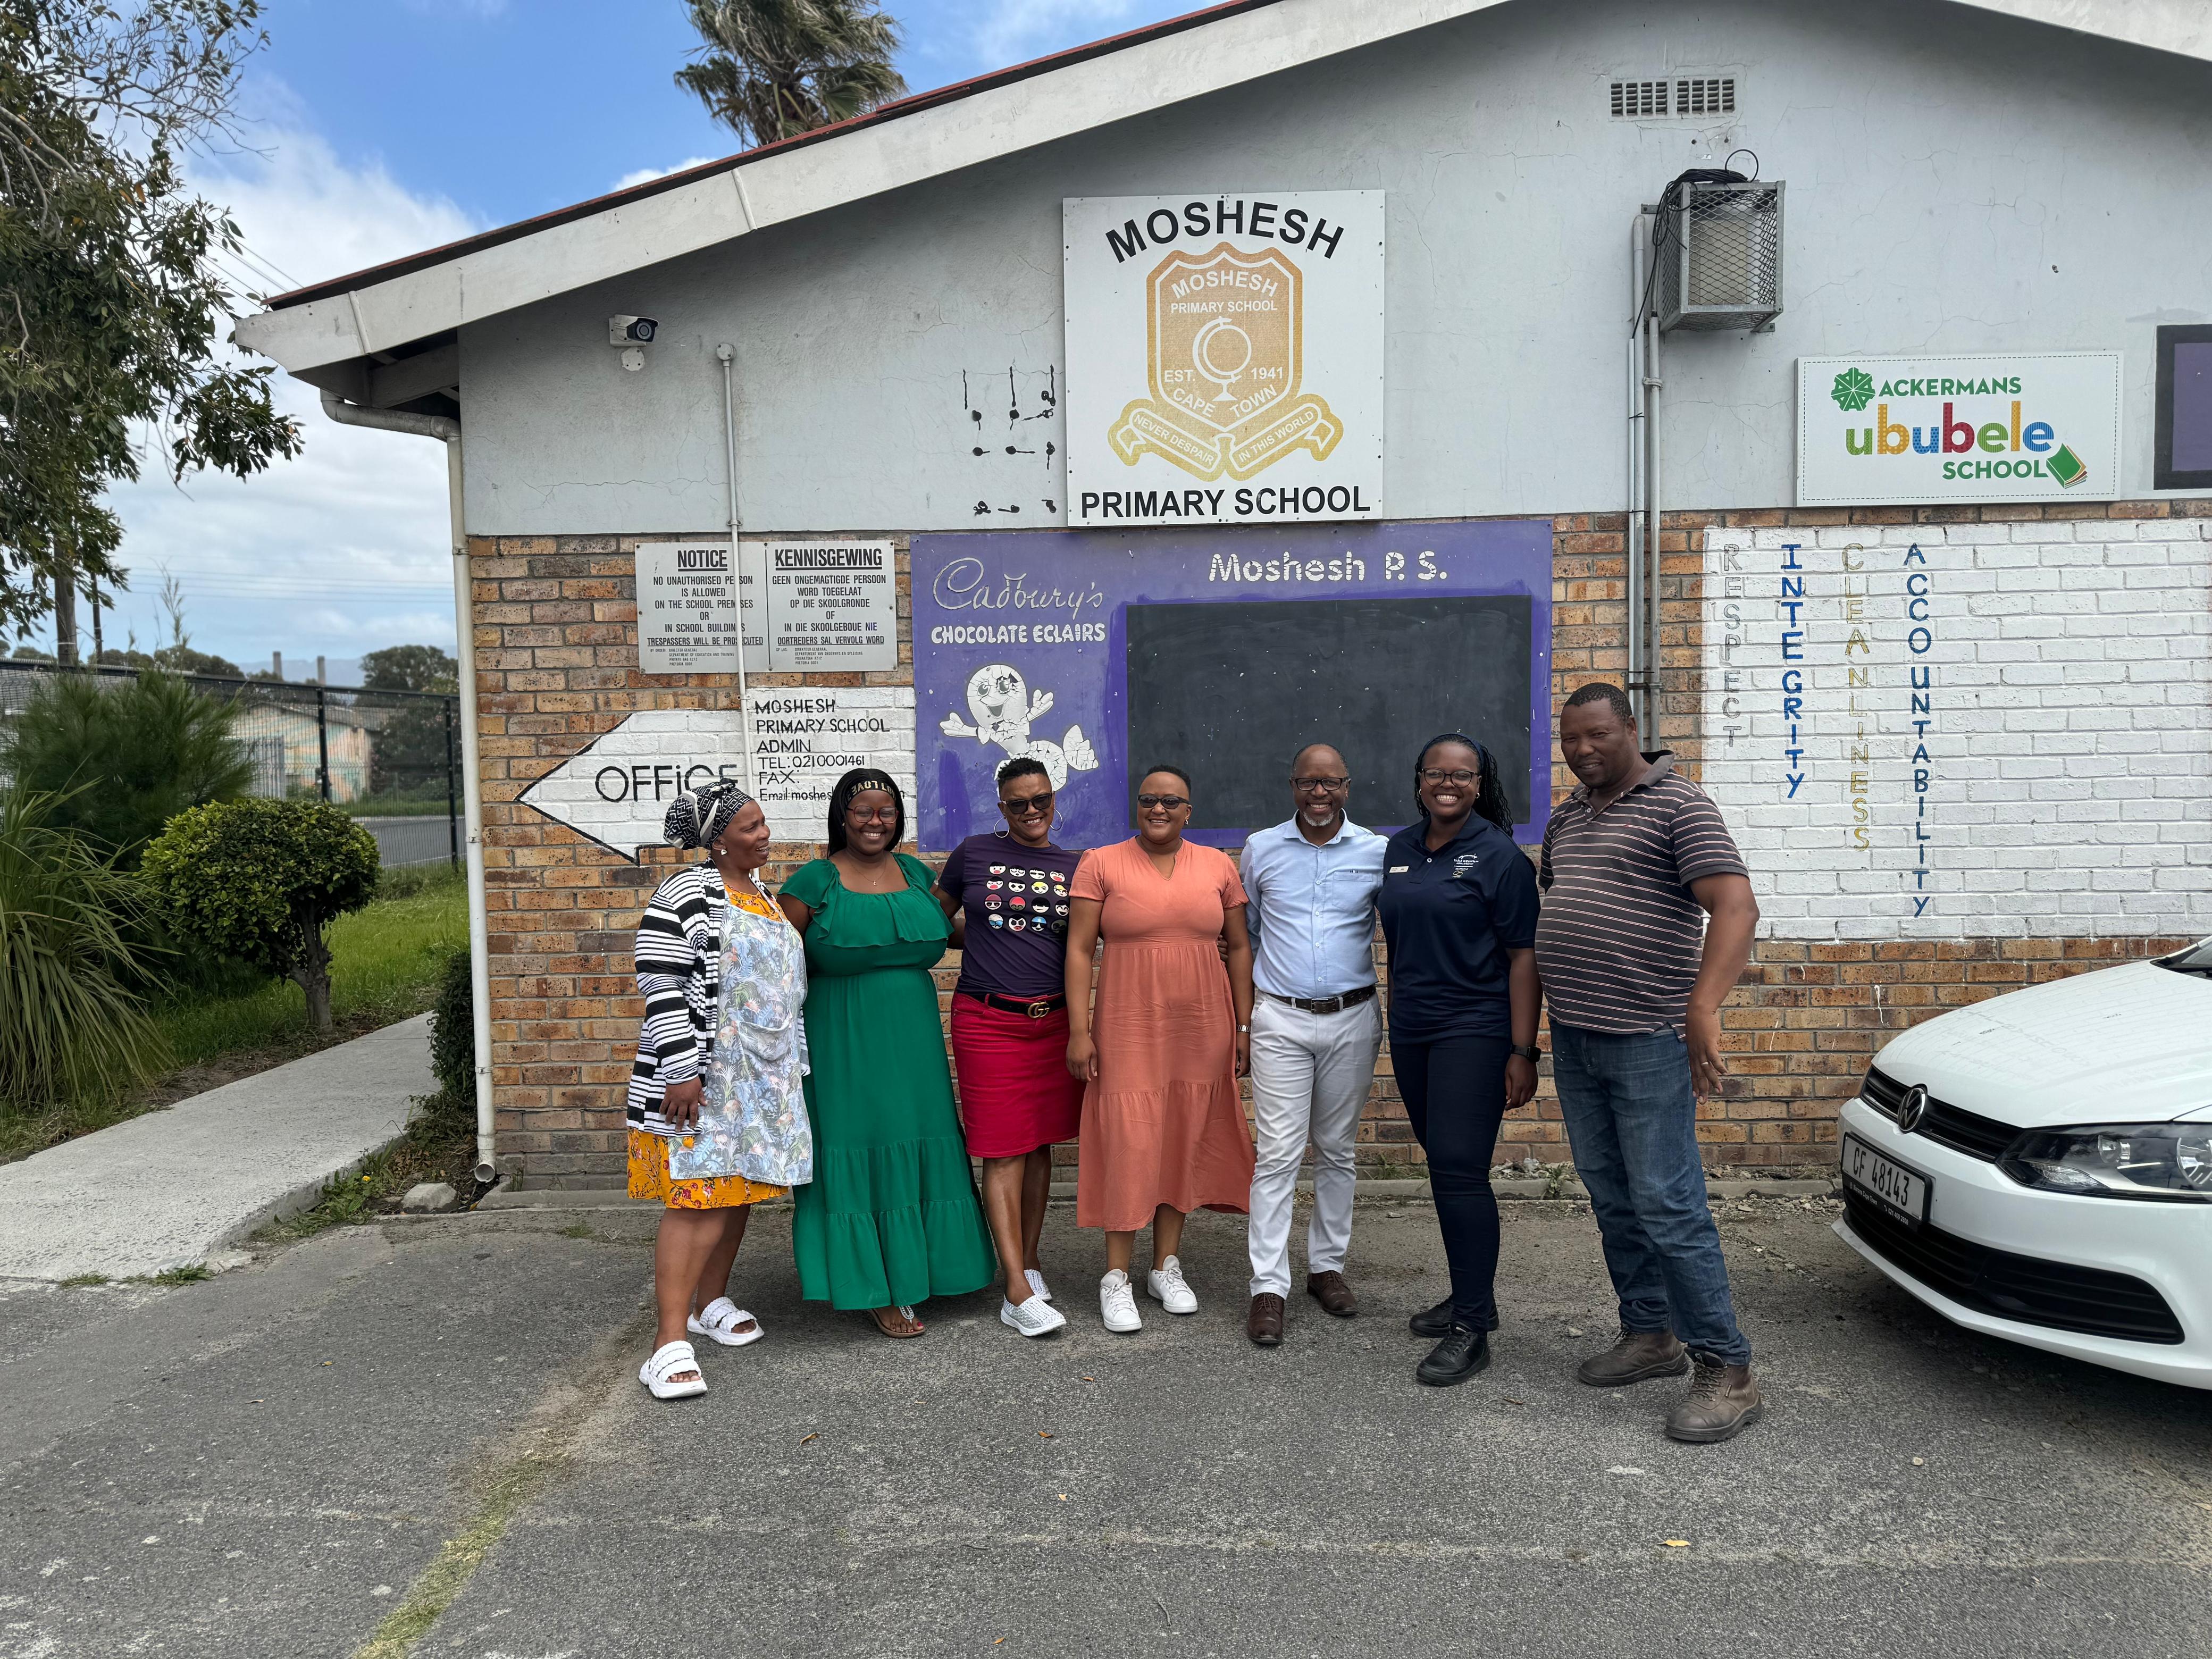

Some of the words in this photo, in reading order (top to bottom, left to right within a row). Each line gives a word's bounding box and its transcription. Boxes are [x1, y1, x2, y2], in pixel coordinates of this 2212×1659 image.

[1105, 200, 1344, 263] MOSHESH
[1171, 270, 1278, 299] MOSHESH
[1171, 302, 1224, 314] PRIMARY
[1227, 300, 1278, 312] SCHOOL
[1164, 370, 1195, 383] EST.
[1251, 367, 1283, 379] 1941
[1879, 377, 2022, 397] ACKERMANS
[1173, 388, 1216, 417] CAPE
[1229, 384, 1277, 418] TOWN
[1238, 451, 1251, 463] IN
[1250, 435, 1275, 454] THIS
[1275, 410, 1314, 439] WORLD
[1846, 400, 2055, 456] ububele
[1134, 414, 1169, 440] NEVER
[1170, 433, 1216, 465] DESPAIR
[1942, 459, 2049, 480] SCHOOL
[1082, 489, 1225, 518] PRIMARY
[1234, 485, 1370, 515] SCHOOL
[678, 550, 727, 567] NOTICE
[775, 549, 882, 566] KENNISGEWING
[1209, 551, 1364, 581] Moshesh
[1385, 552, 1405, 581] P.
[1418, 551, 1447, 581] S.
[653, 577, 663, 585] NO
[667, 576, 721, 585] UNAUTHORISED
[773, 576, 791, 584] GEEN
[795, 575, 850, 584] ONGEMAGTIGDE
[854, 575, 886, 583] PERSOON
[682, 588, 688, 597] IS
[692, 588, 725, 597] ALLOWED
[798, 588, 818, 596] WORD
[822, 587, 861, 596] TOEGELAAT
[933, 557, 1103, 621] Cadbury's
[655, 600, 664, 609] ON
[686, 600, 714, 608] SCHOOL
[718, 600, 753, 608] PREMSES
[803, 599, 815, 608] DIE
[818, 599, 870, 607] SKOOLGRONDE
[826, 611, 835, 619] OF
[665, 624, 672, 632] IN
[676, 624, 704, 632] SCHOOL
[708, 623, 745, 632] BUILDINS
[811, 623, 861, 631] SKOOLGEBOUE
[931, 625, 1028, 643] CHOCOLATE
[1033, 623, 1105, 642] ECLAIRS
[1722, 543, 1742, 748] RESPECT
[1780, 543, 1806, 798] INTEGRITY
[1841, 542, 1870, 851] CLEANLINESS
[755, 699, 835, 715] MOSHESH
[757, 719, 825, 734] PRIMARY
[830, 718, 890, 733] SCHOOL
[1903, 542, 1932, 918] ACCOUNTABILITY
[757, 739, 810, 753] ADMIN
[759, 769, 800, 785] FAX:
[1853, 1147, 1866, 1178] CF
[1872, 1159, 1909, 1206] 48143
